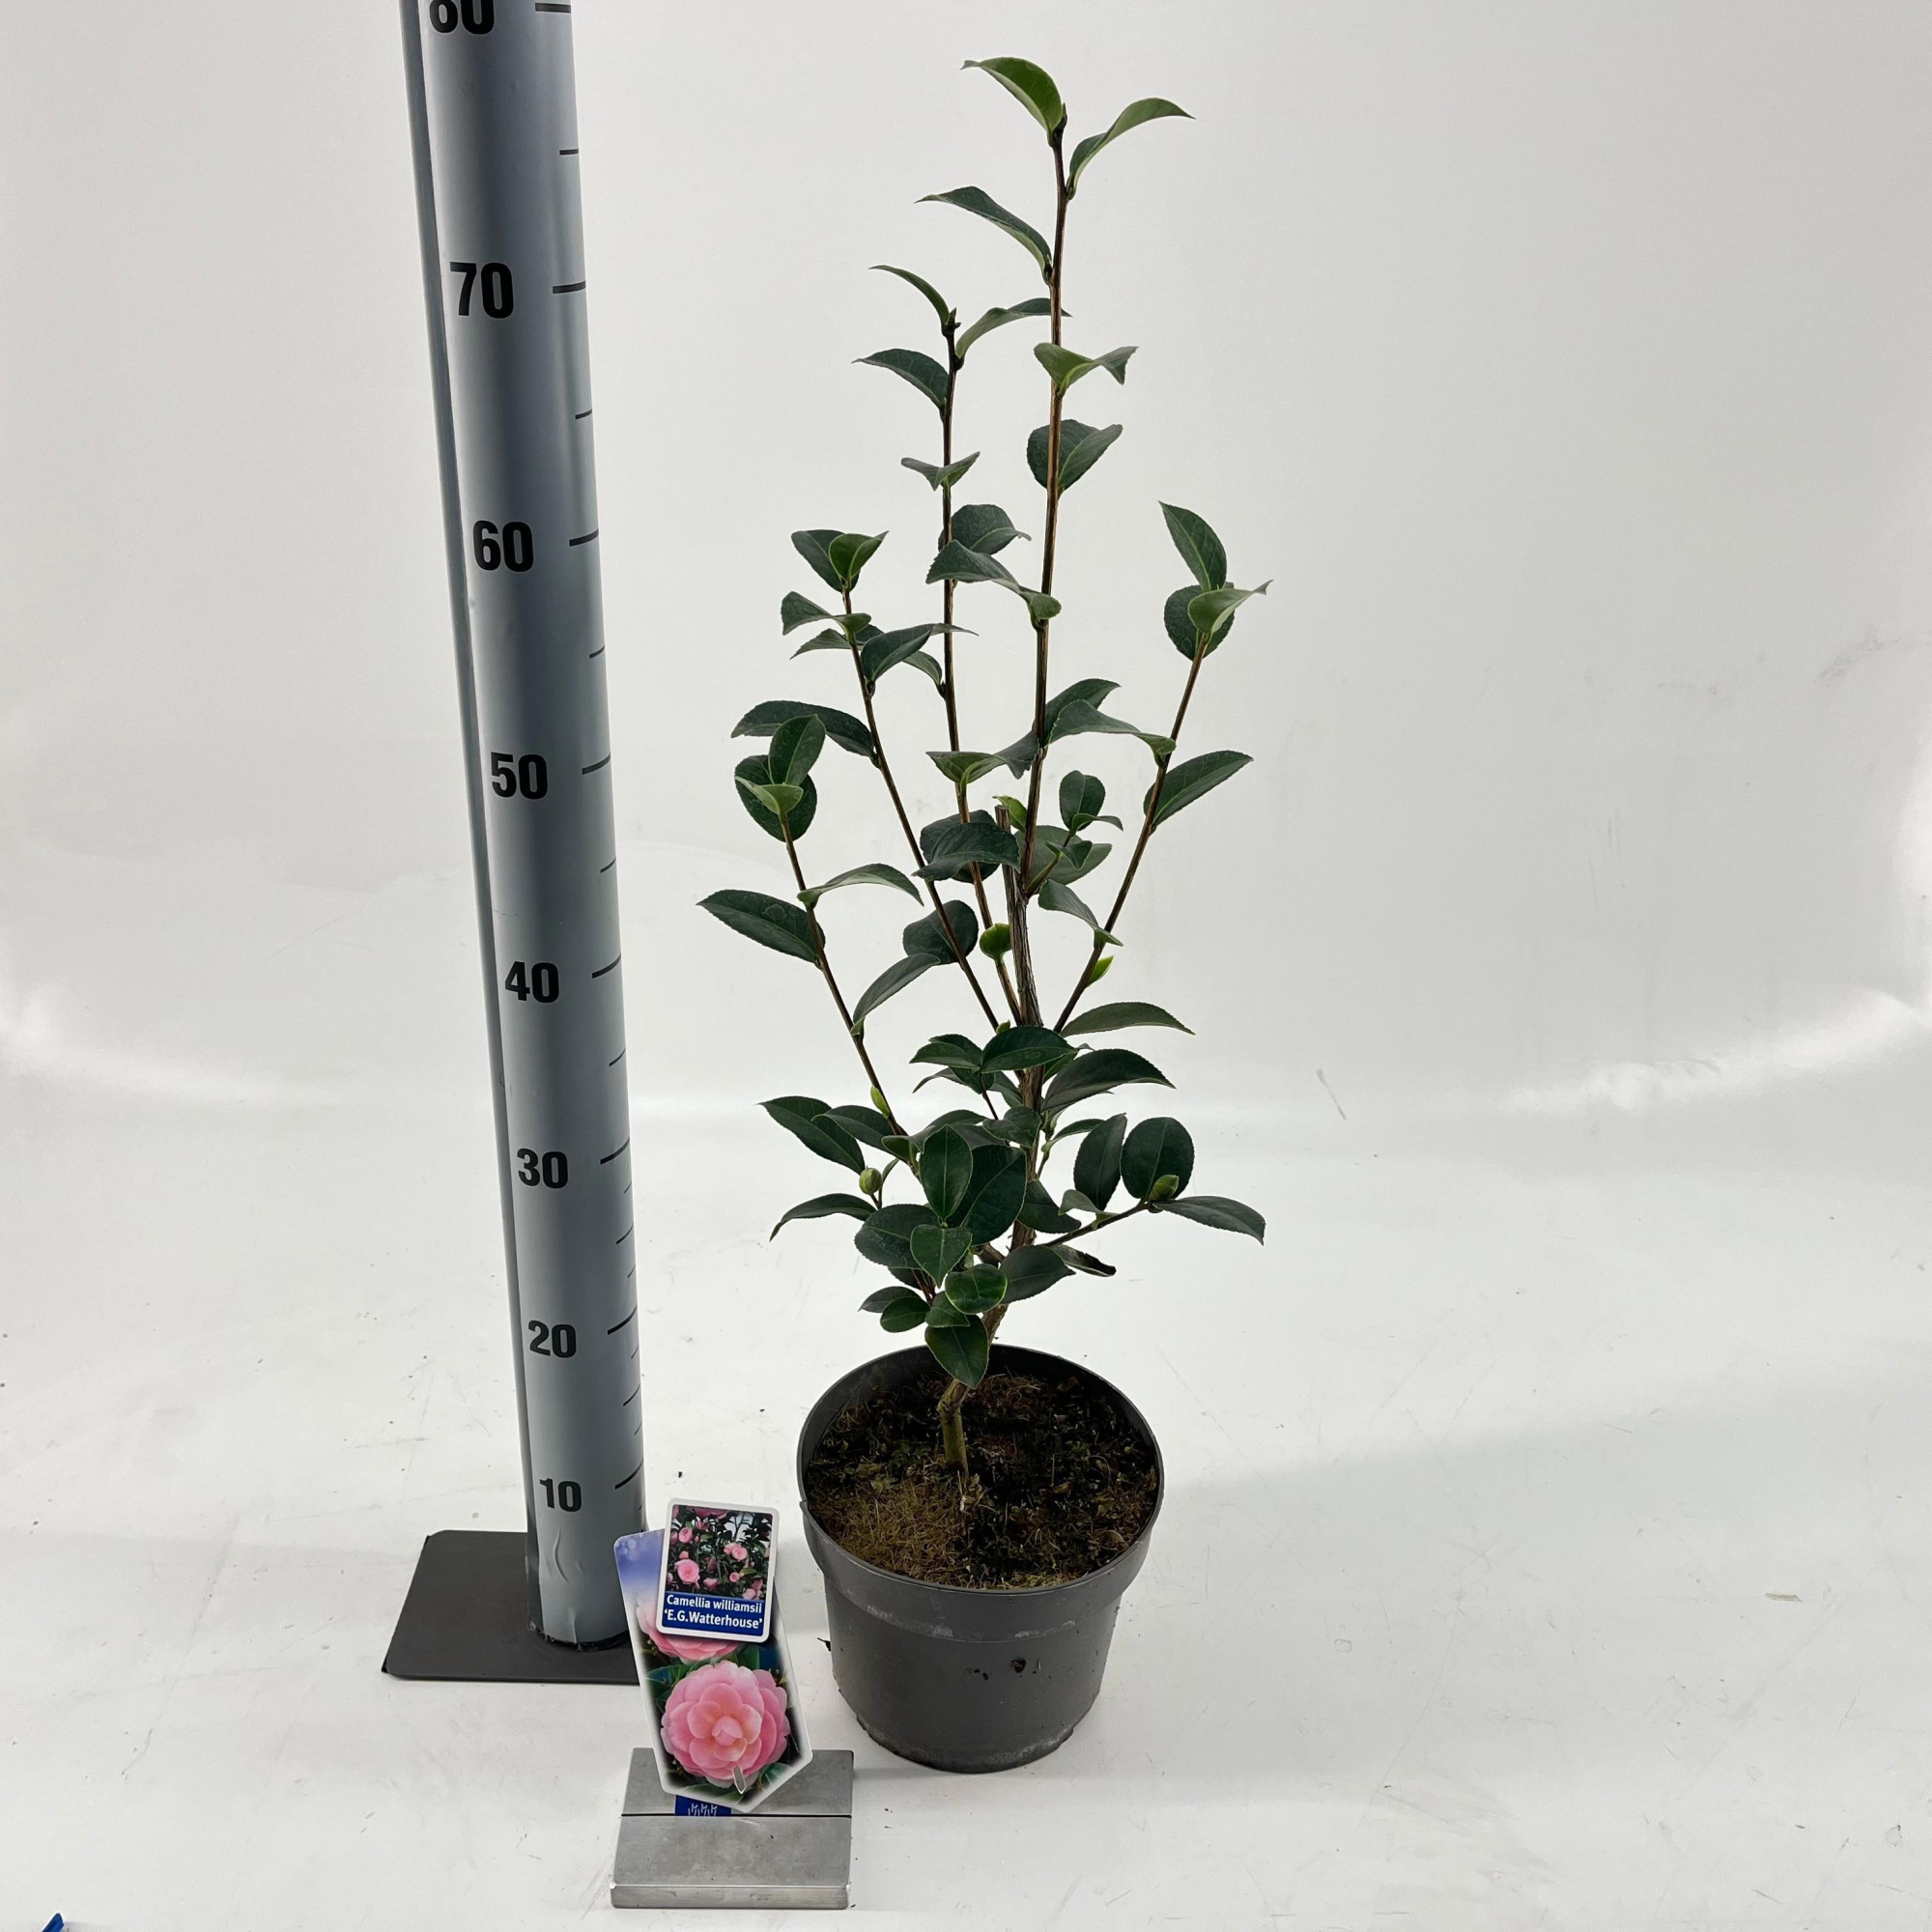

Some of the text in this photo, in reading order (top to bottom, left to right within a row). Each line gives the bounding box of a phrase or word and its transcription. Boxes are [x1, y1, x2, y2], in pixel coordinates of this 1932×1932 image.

[430, 0, 495, 35] 80
[450, 262, 514, 319] 70
[474, 521, 533, 572] 60
[491, 753, 548, 800] 50
[505, 961, 560, 1003] 40
[517, 1149, 568, 1189] 30
[528, 1320, 577, 1358] 20
[539, 1478, 582, 1512] 10
[667, 1595, 762, 1613] Camellia williamsii
